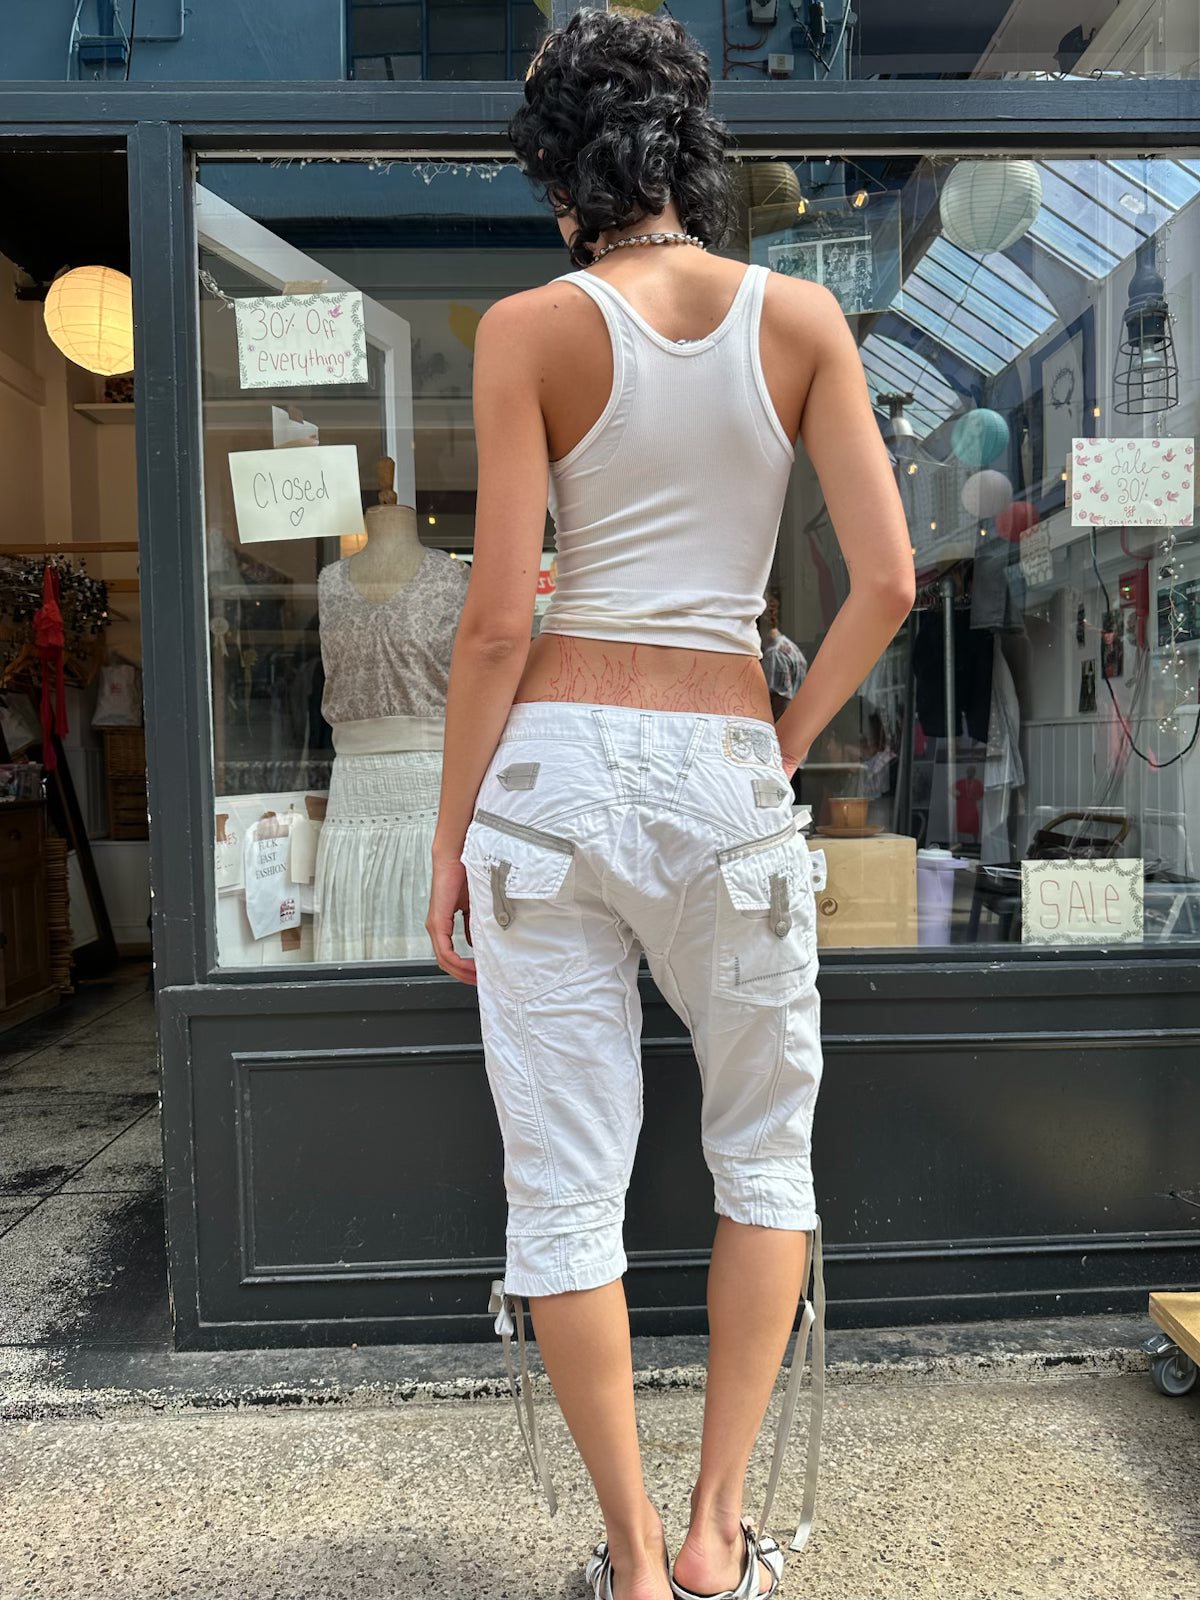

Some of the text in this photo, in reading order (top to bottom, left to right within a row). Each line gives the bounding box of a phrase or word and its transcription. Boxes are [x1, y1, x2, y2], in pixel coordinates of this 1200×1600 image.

[250, 308, 295, 341] 30%
[258, 349, 345, 378] everything
[1111, 447, 1160, 476] Sale
[252, 470, 330, 509] Closed
[1117, 477, 1149, 505] 30%
[255, 863, 288, 880] FASHION
[260, 852, 277, 865] FAST
